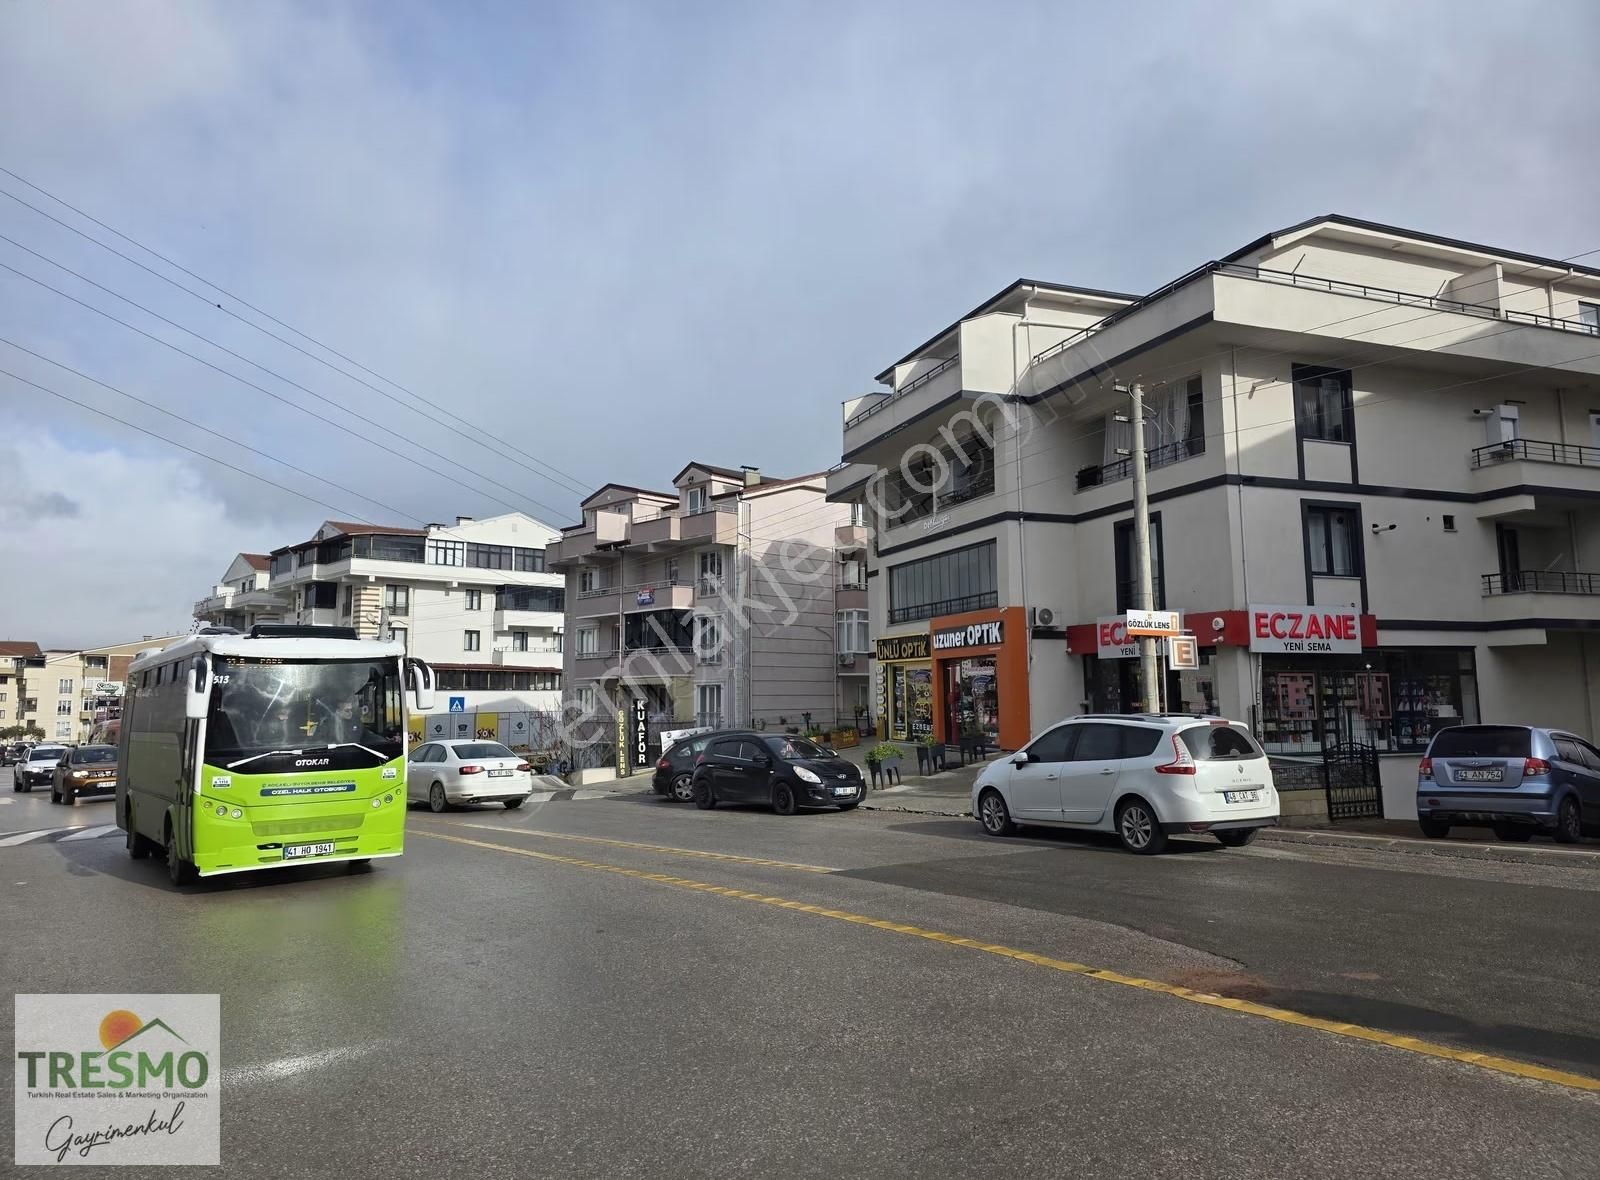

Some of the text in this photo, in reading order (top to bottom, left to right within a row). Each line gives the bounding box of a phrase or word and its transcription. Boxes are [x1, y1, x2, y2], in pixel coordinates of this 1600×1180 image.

[1128, 619, 1170, 630] GÖZLÜK LENS
[1255, 612, 1357, 640] ECZANE
[878, 640, 900, 660] ÜNLÜ
[1307, 642, 1332, 652] SEMA
[637, 700, 646, 764] KUAFÖR
[295, 758, 329, 767] OTOKAR
[288, 847, 297, 856] 41
[315, 844, 331, 853] 1941
